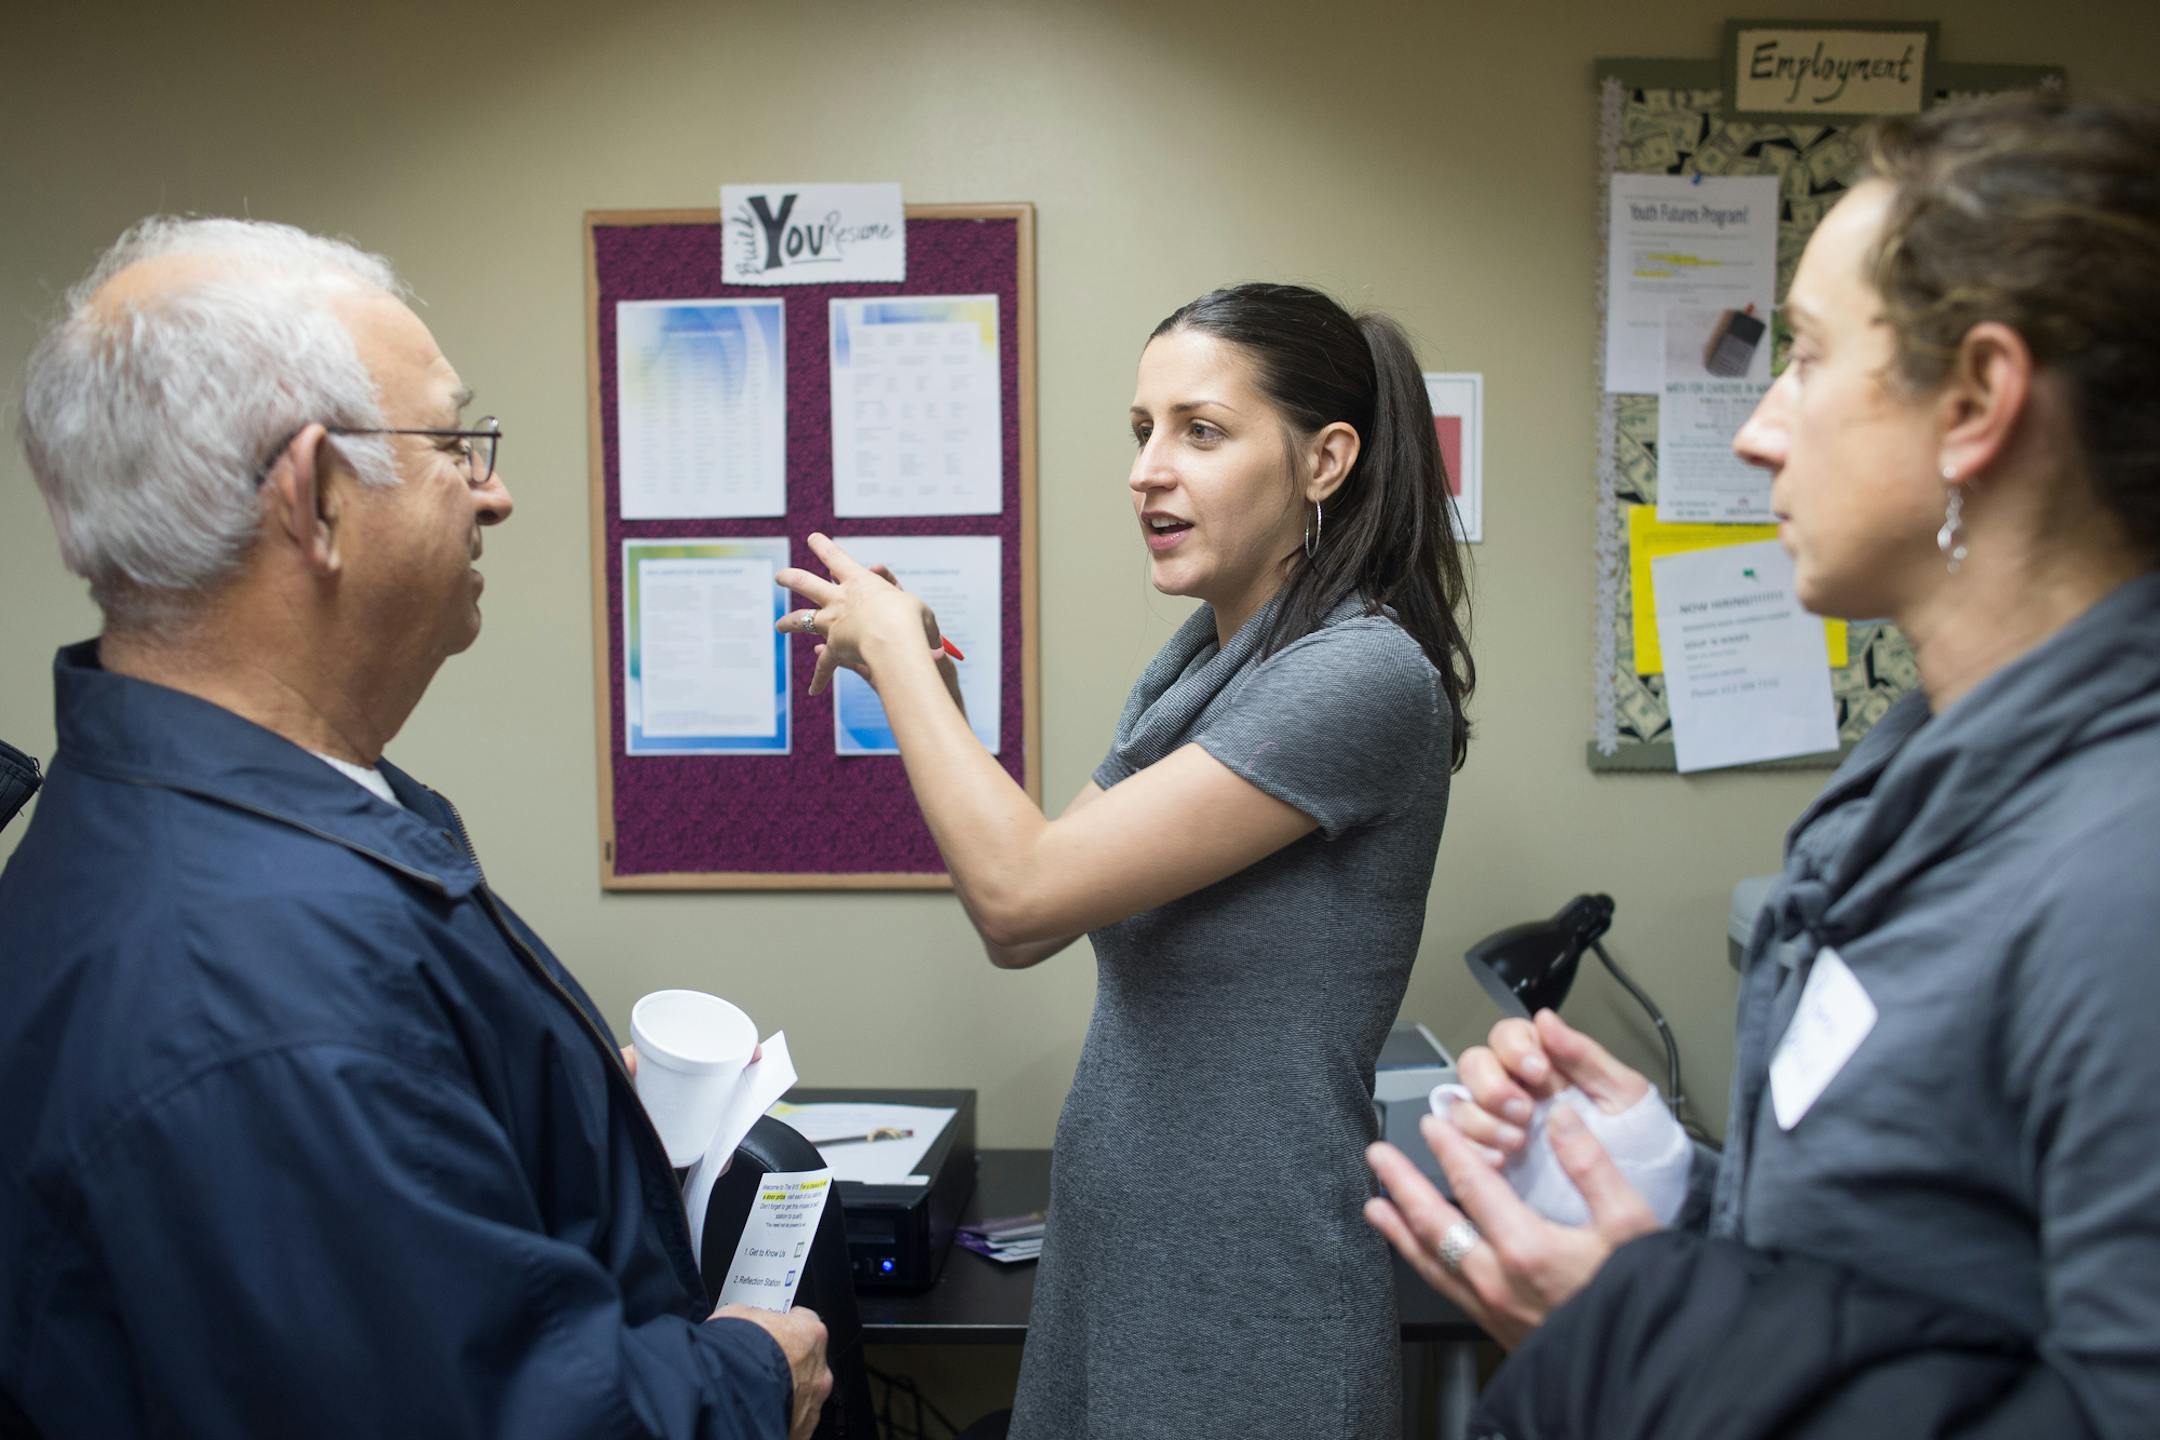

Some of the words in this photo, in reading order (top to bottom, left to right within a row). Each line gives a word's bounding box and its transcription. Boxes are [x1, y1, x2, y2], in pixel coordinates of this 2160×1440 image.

[1750, 39, 1914, 104] Employment
[1630, 203, 1658, 221] Youth
[1661, 203, 1698, 223] Futures
[1679, 601, 1708, 615] NOW
[749, 1248, 758, 1256] Get
[764, 1249, 778, 1257] Know
[739, 1276, 763, 1286] Reflection
[764, 1278, 781, 1287] Station
